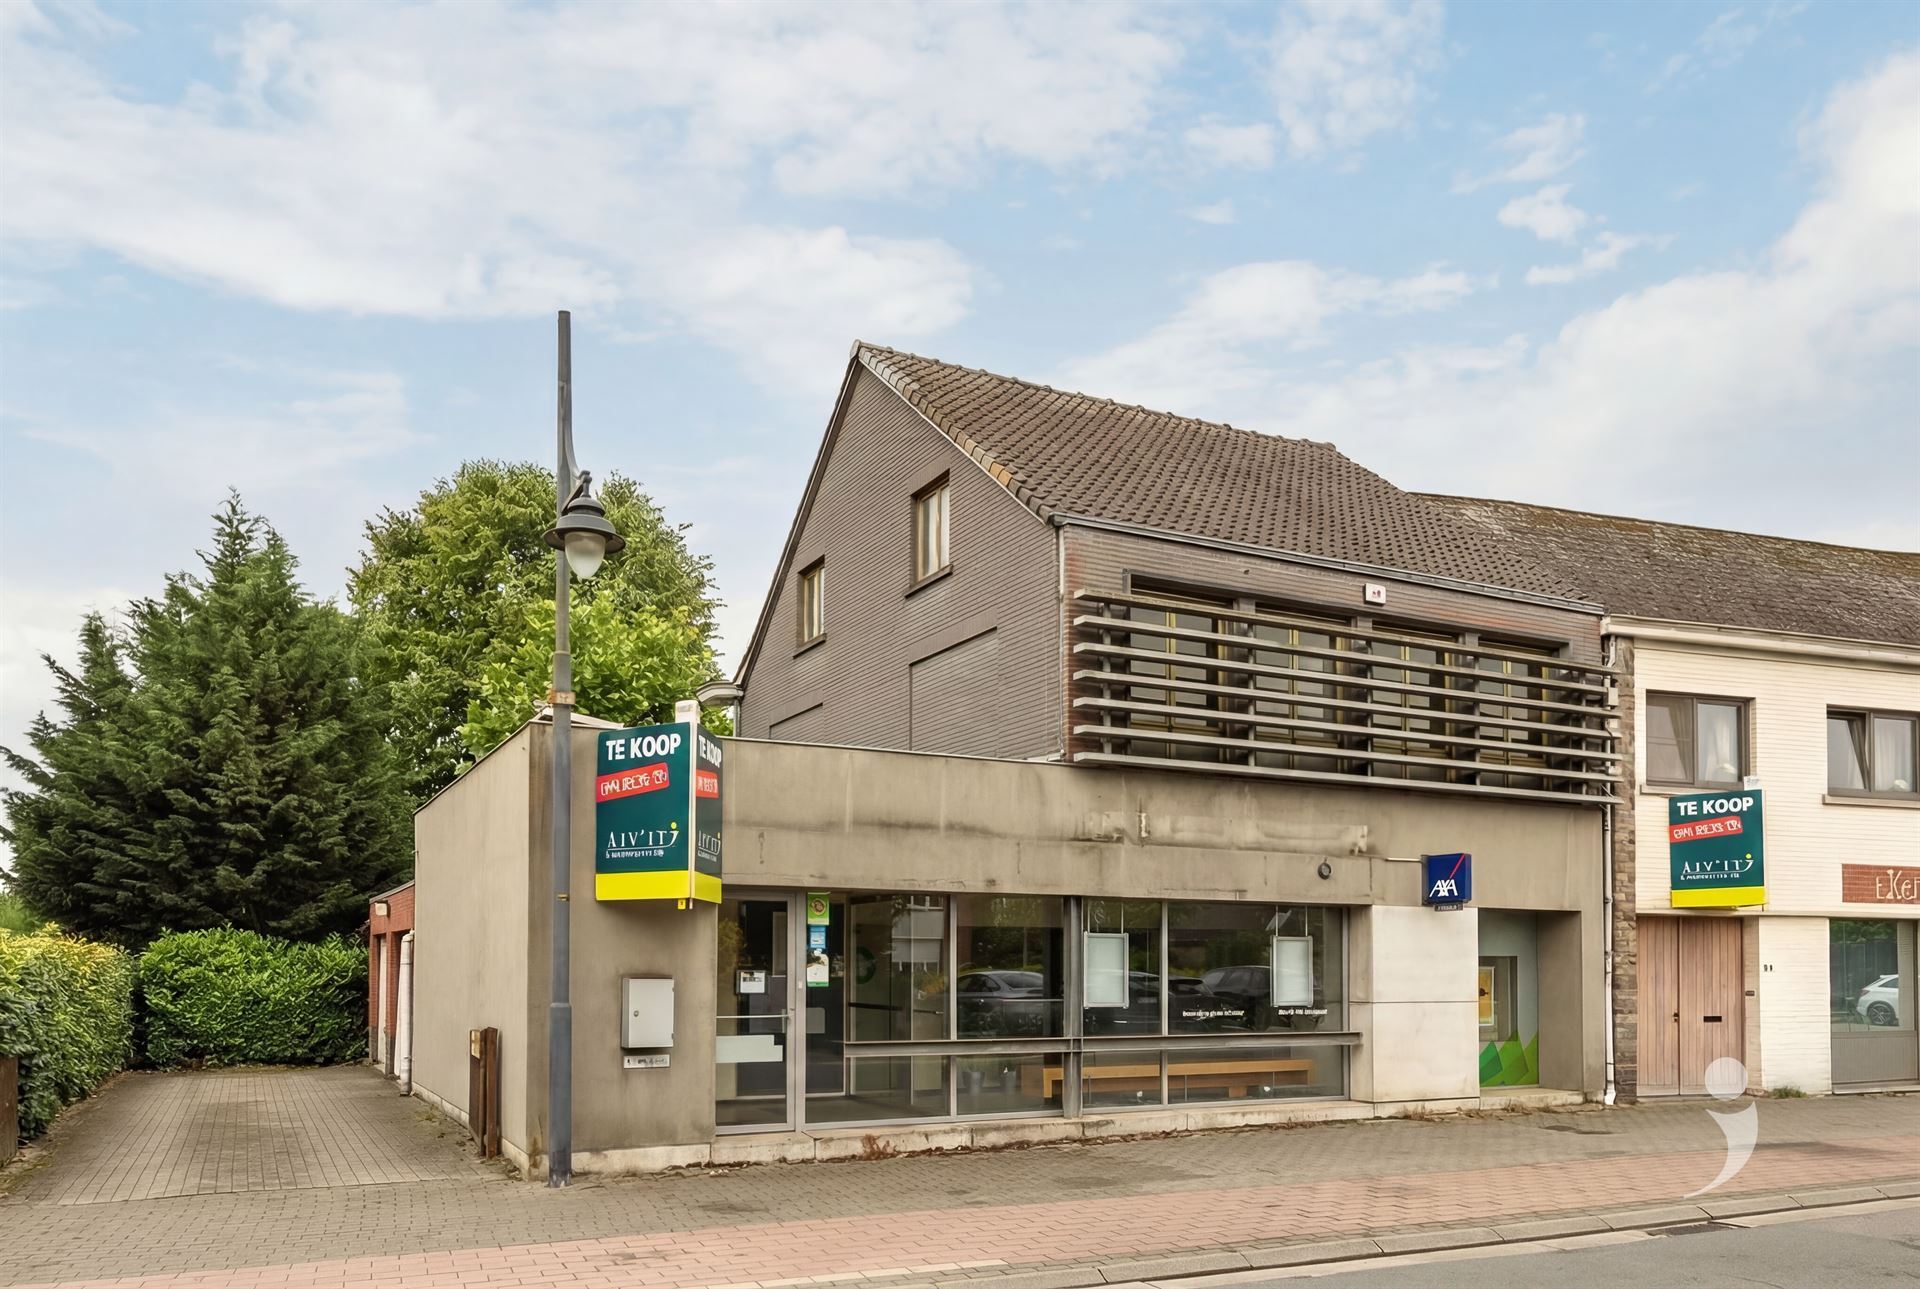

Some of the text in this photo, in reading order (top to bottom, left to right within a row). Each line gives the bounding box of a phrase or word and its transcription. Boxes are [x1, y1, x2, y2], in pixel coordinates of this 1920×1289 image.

[606, 733, 682, 760] TE KOOP
[1677, 797, 1754, 816] TE KOOP
[1429, 879, 1458, 898] AXA
